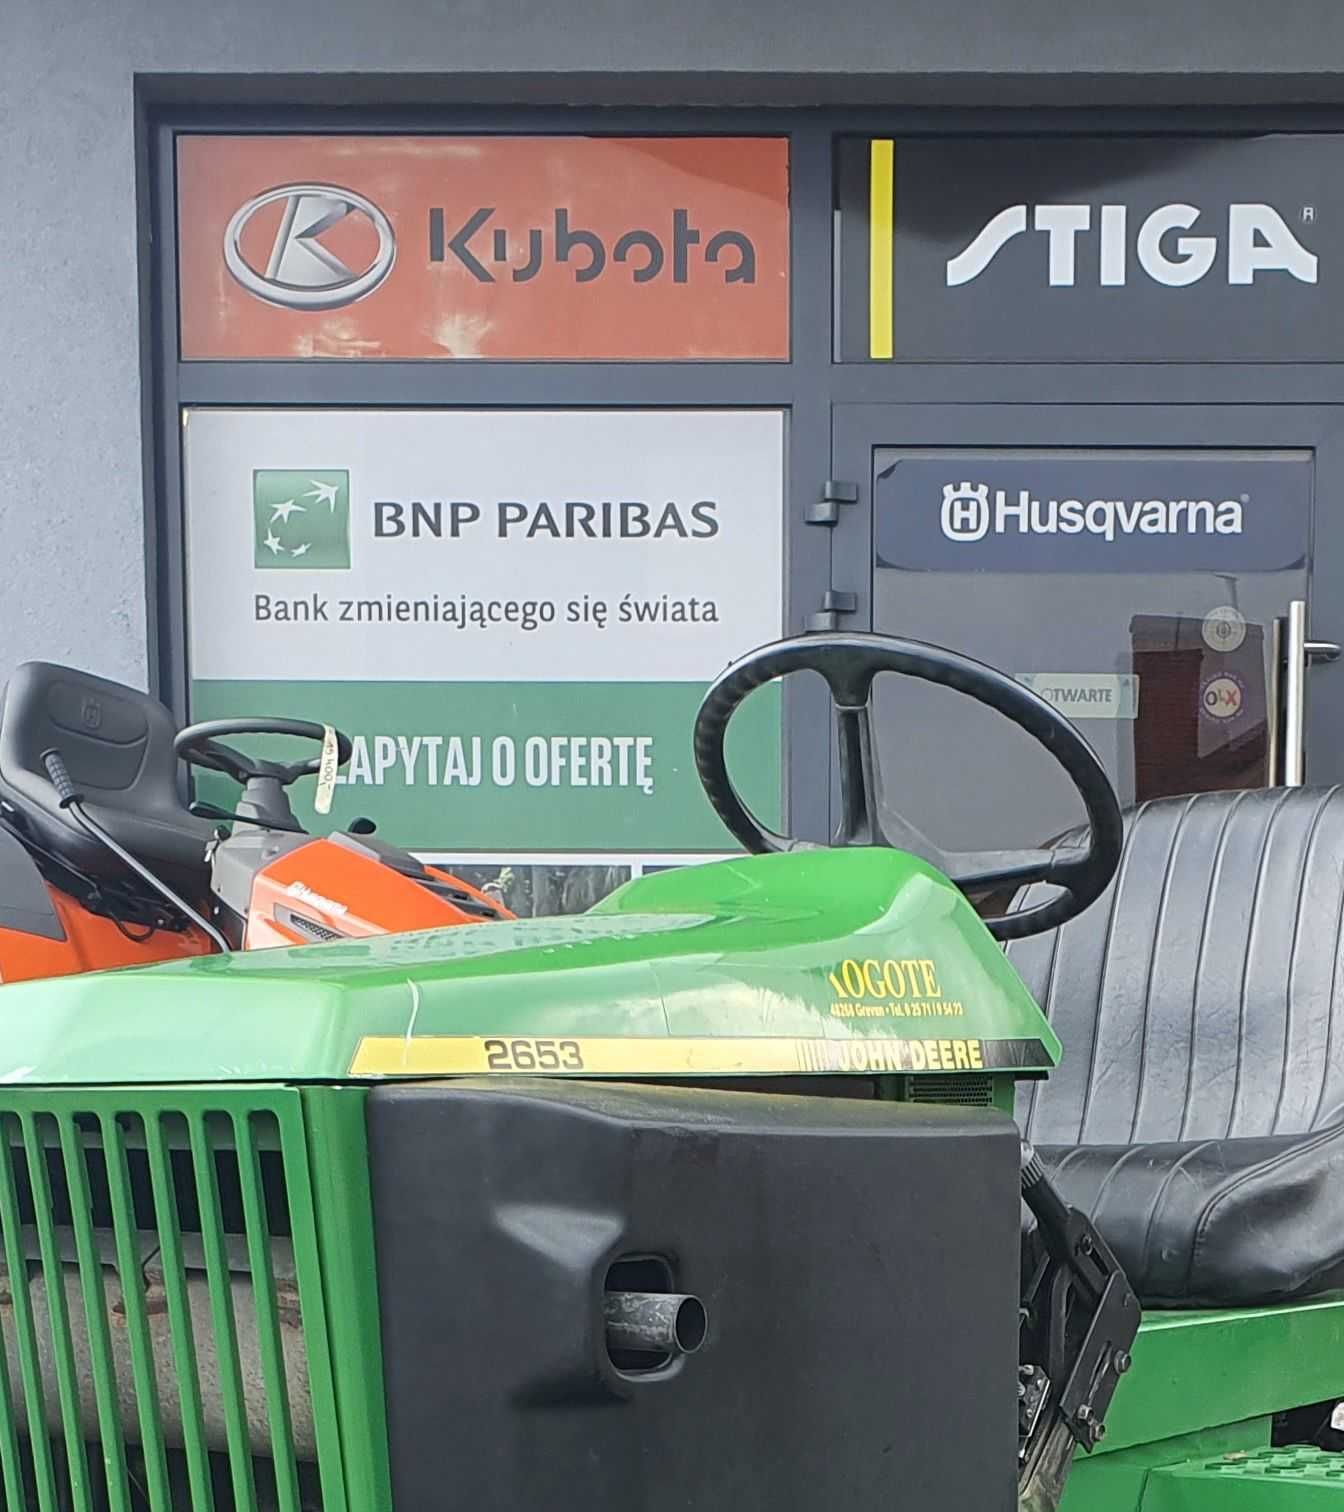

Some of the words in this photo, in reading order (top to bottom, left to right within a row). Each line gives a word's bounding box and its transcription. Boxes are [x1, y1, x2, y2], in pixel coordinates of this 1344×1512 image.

[428, 207, 756, 283] Kubota
[946, 203, 1318, 286] STIGA
[373, 501, 480, 538] BNP
[498, 501, 719, 538] PARIBAS
[996, 491, 1243, 541] Husqvarna
[254, 594, 329, 622] Bank
[339, 595, 556, 630] zmieniającego
[567, 594, 608, 628] się
[619, 593, 718, 622] świata
[336, 736, 482, 786] APYTAJ
[492, 736, 515, 786] O
[525, 736, 653, 794] OFERTĘ
[484, 1040, 584, 1071] 2653
[837, 1040, 903, 1071] JOHN
[909, 1039, 984, 1070] DEERE
